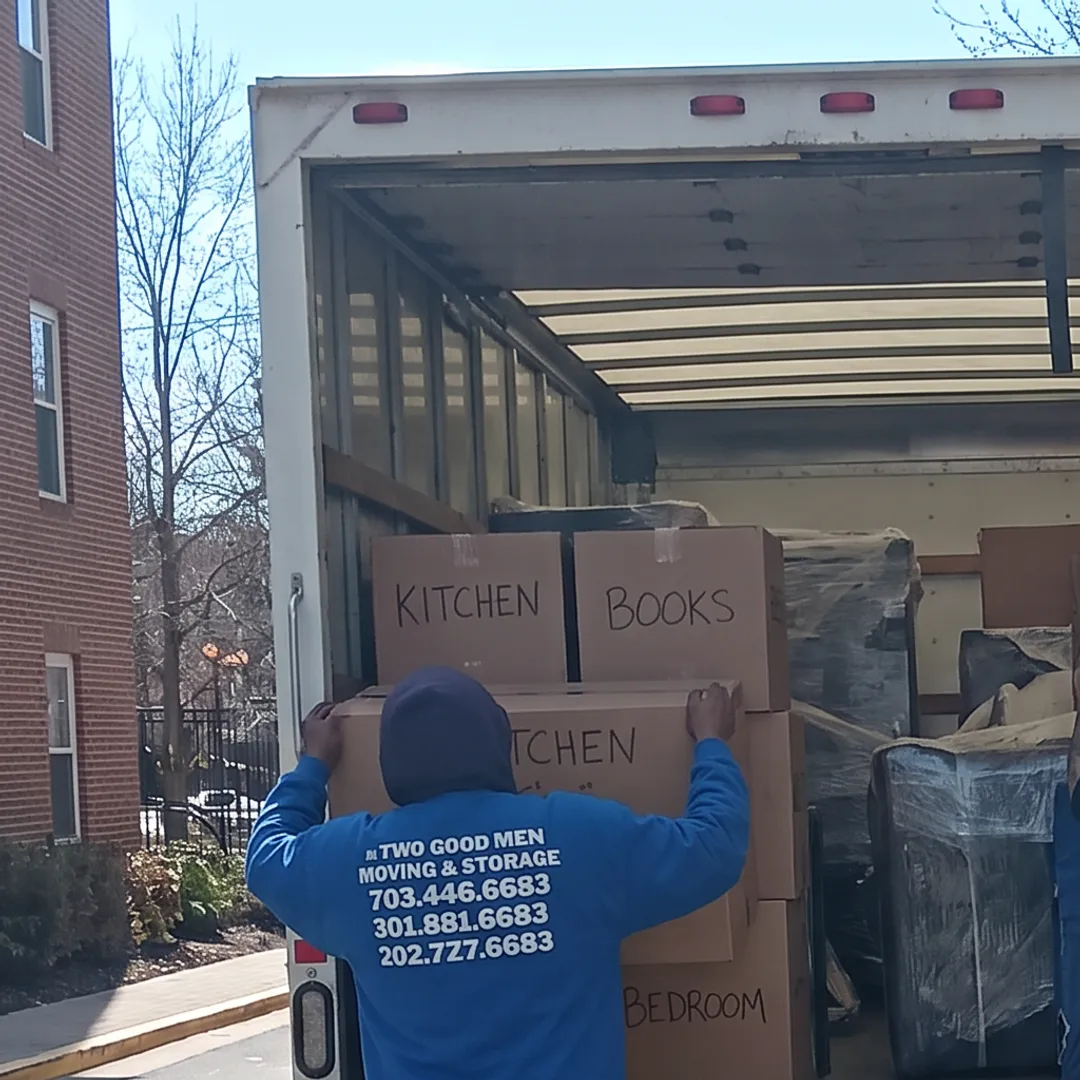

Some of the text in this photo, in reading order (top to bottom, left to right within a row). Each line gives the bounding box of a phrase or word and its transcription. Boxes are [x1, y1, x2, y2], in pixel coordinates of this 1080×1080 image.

[395, 580, 540, 628] KITCHEN
[605, 586, 736, 630] BOOKS
[511, 726, 637, 767] TCHEN
[379, 840, 425, 860] TWO
[429, 834, 490, 855] GOOD
[493, 827, 546, 849] MEN
[358, 849, 562, 884] MOVING & STORAGE
[368, 873, 551, 911] 703.446.6683
[372, 902, 549, 939] 301.881.6683
[622, 986, 767, 1029] BEDROOM
